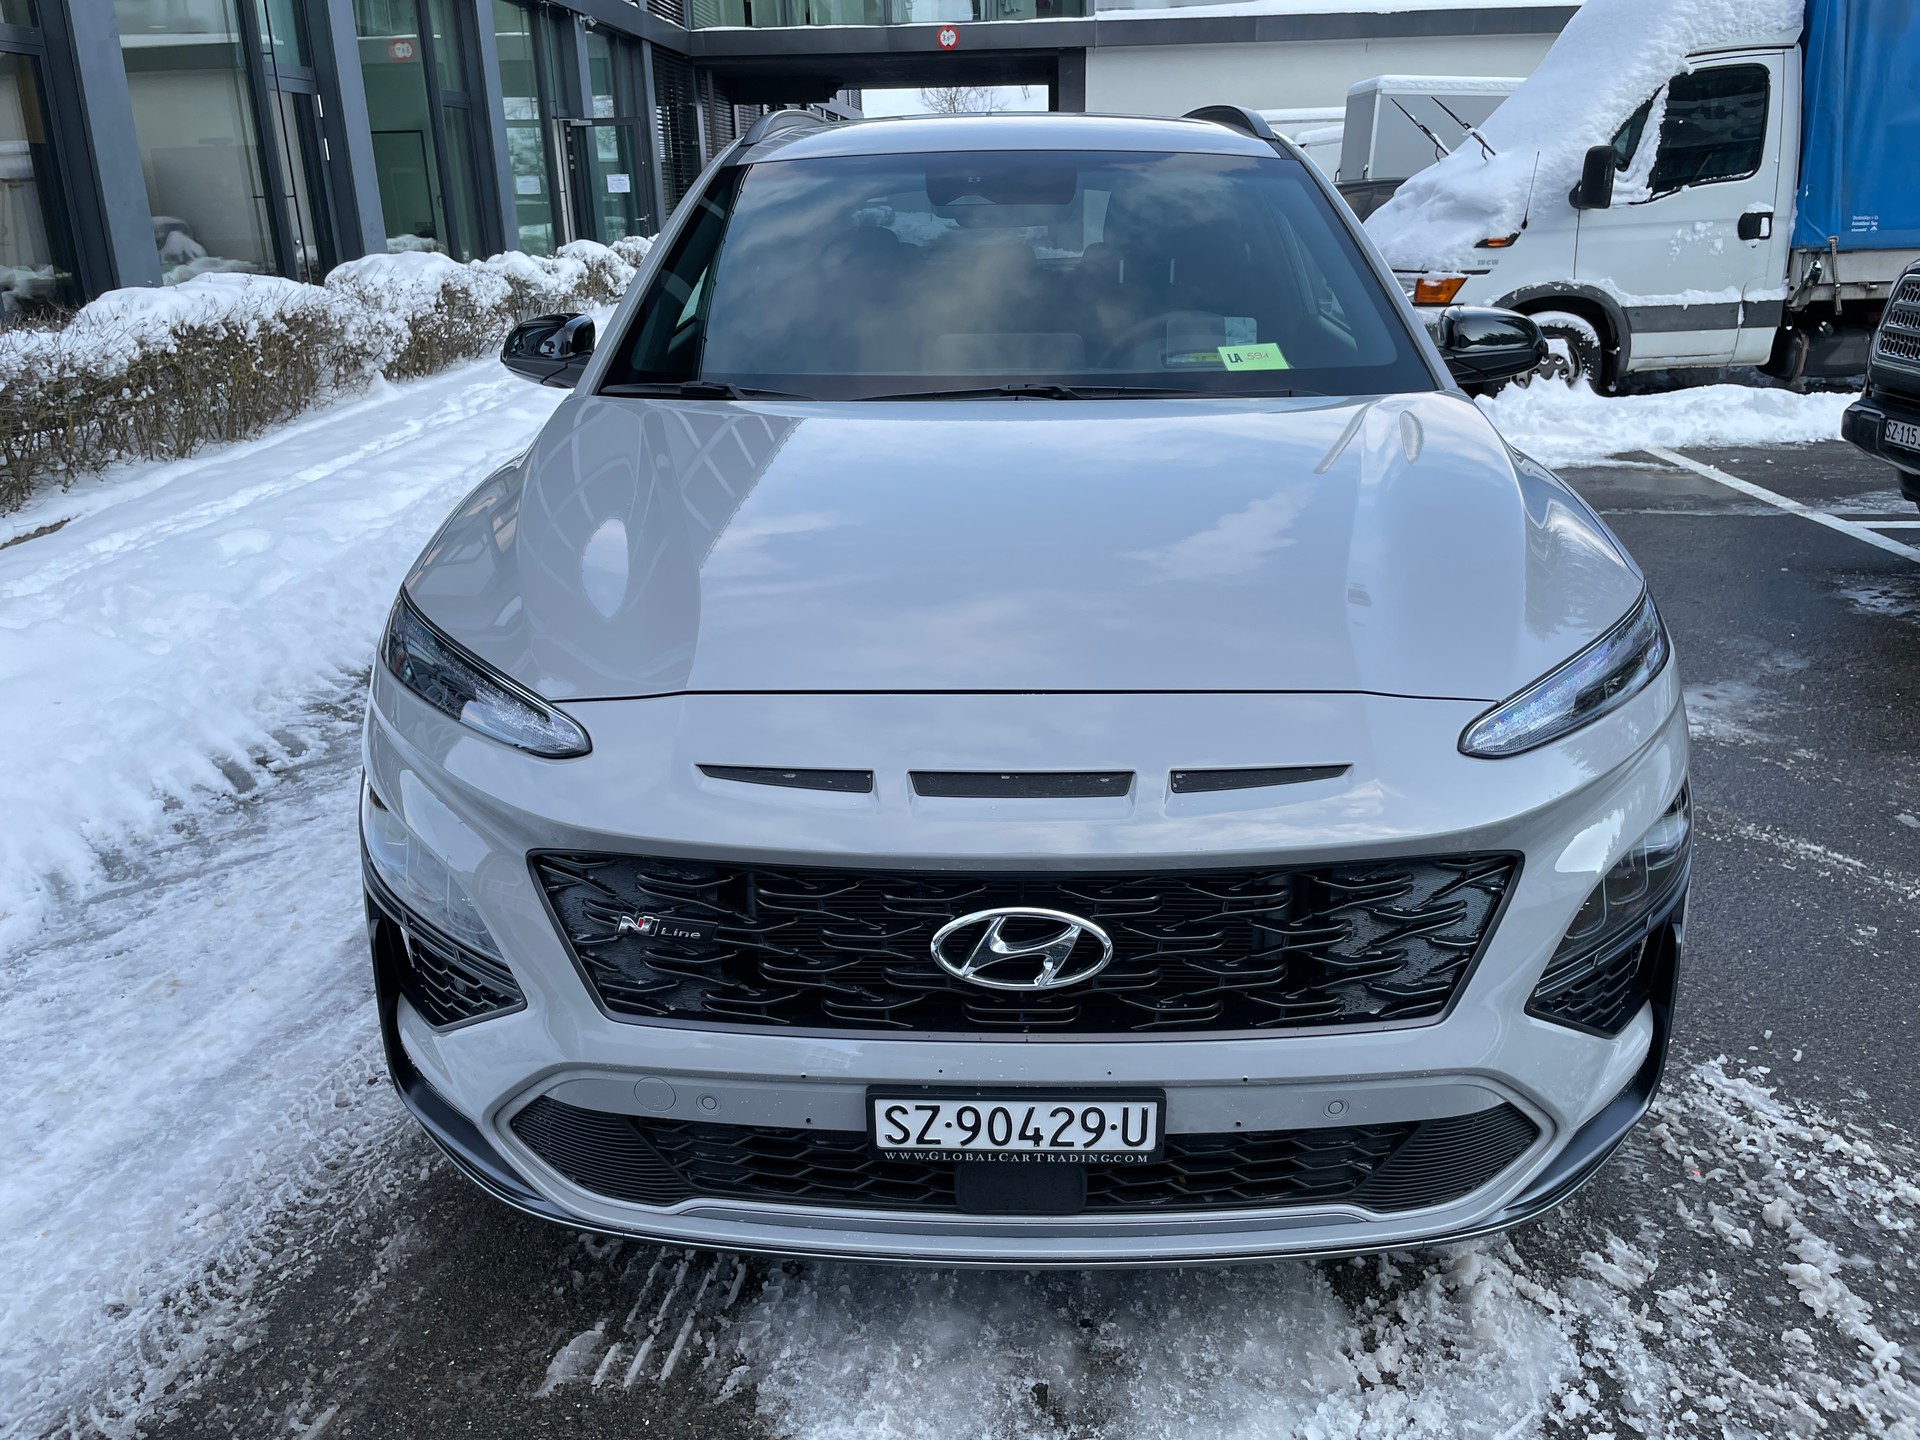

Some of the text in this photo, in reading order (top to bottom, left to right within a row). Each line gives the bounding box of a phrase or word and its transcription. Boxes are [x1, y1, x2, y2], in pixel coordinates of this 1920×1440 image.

[1227, 353, 1243, 363] LA
[1885, 421, 1920, 446] SZ·115
[660, 927, 701, 940] Line
